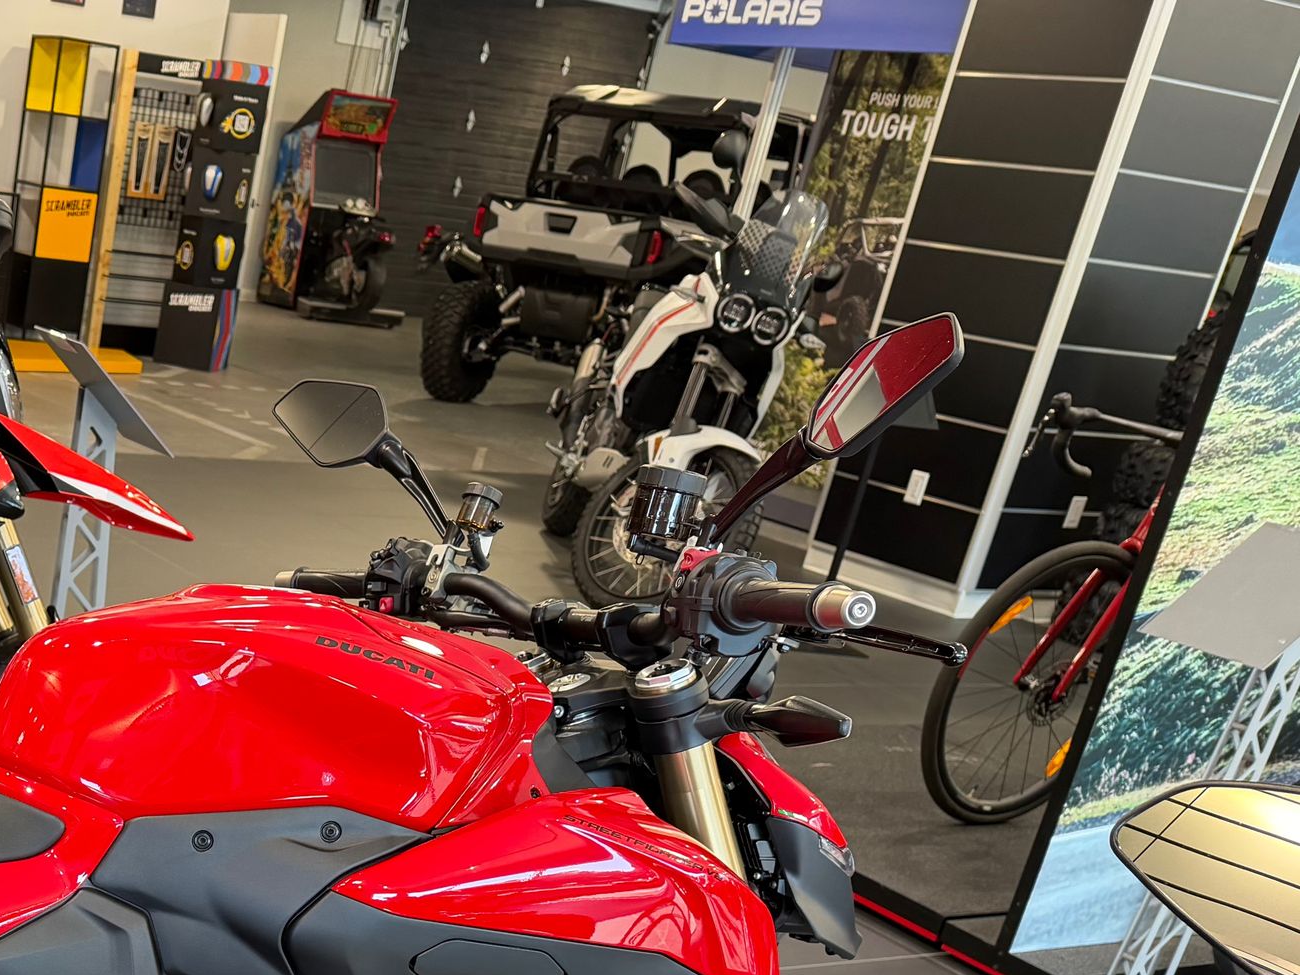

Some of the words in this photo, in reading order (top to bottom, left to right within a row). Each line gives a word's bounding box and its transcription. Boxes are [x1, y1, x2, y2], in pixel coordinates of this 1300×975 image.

[681, 0, 824, 26] POLARIS
[868, 91, 900, 106] PUSH
[903, 94, 933, 109] YOUR
[840, 109, 918, 142] TOUGH
[45, 199, 92, 212] SCRAMBLER
[169, 293, 215, 306] SCRAMBLER
[315, 635, 435, 680] DUCATI
[563, 814, 704, 872] STREETFIGHTER
